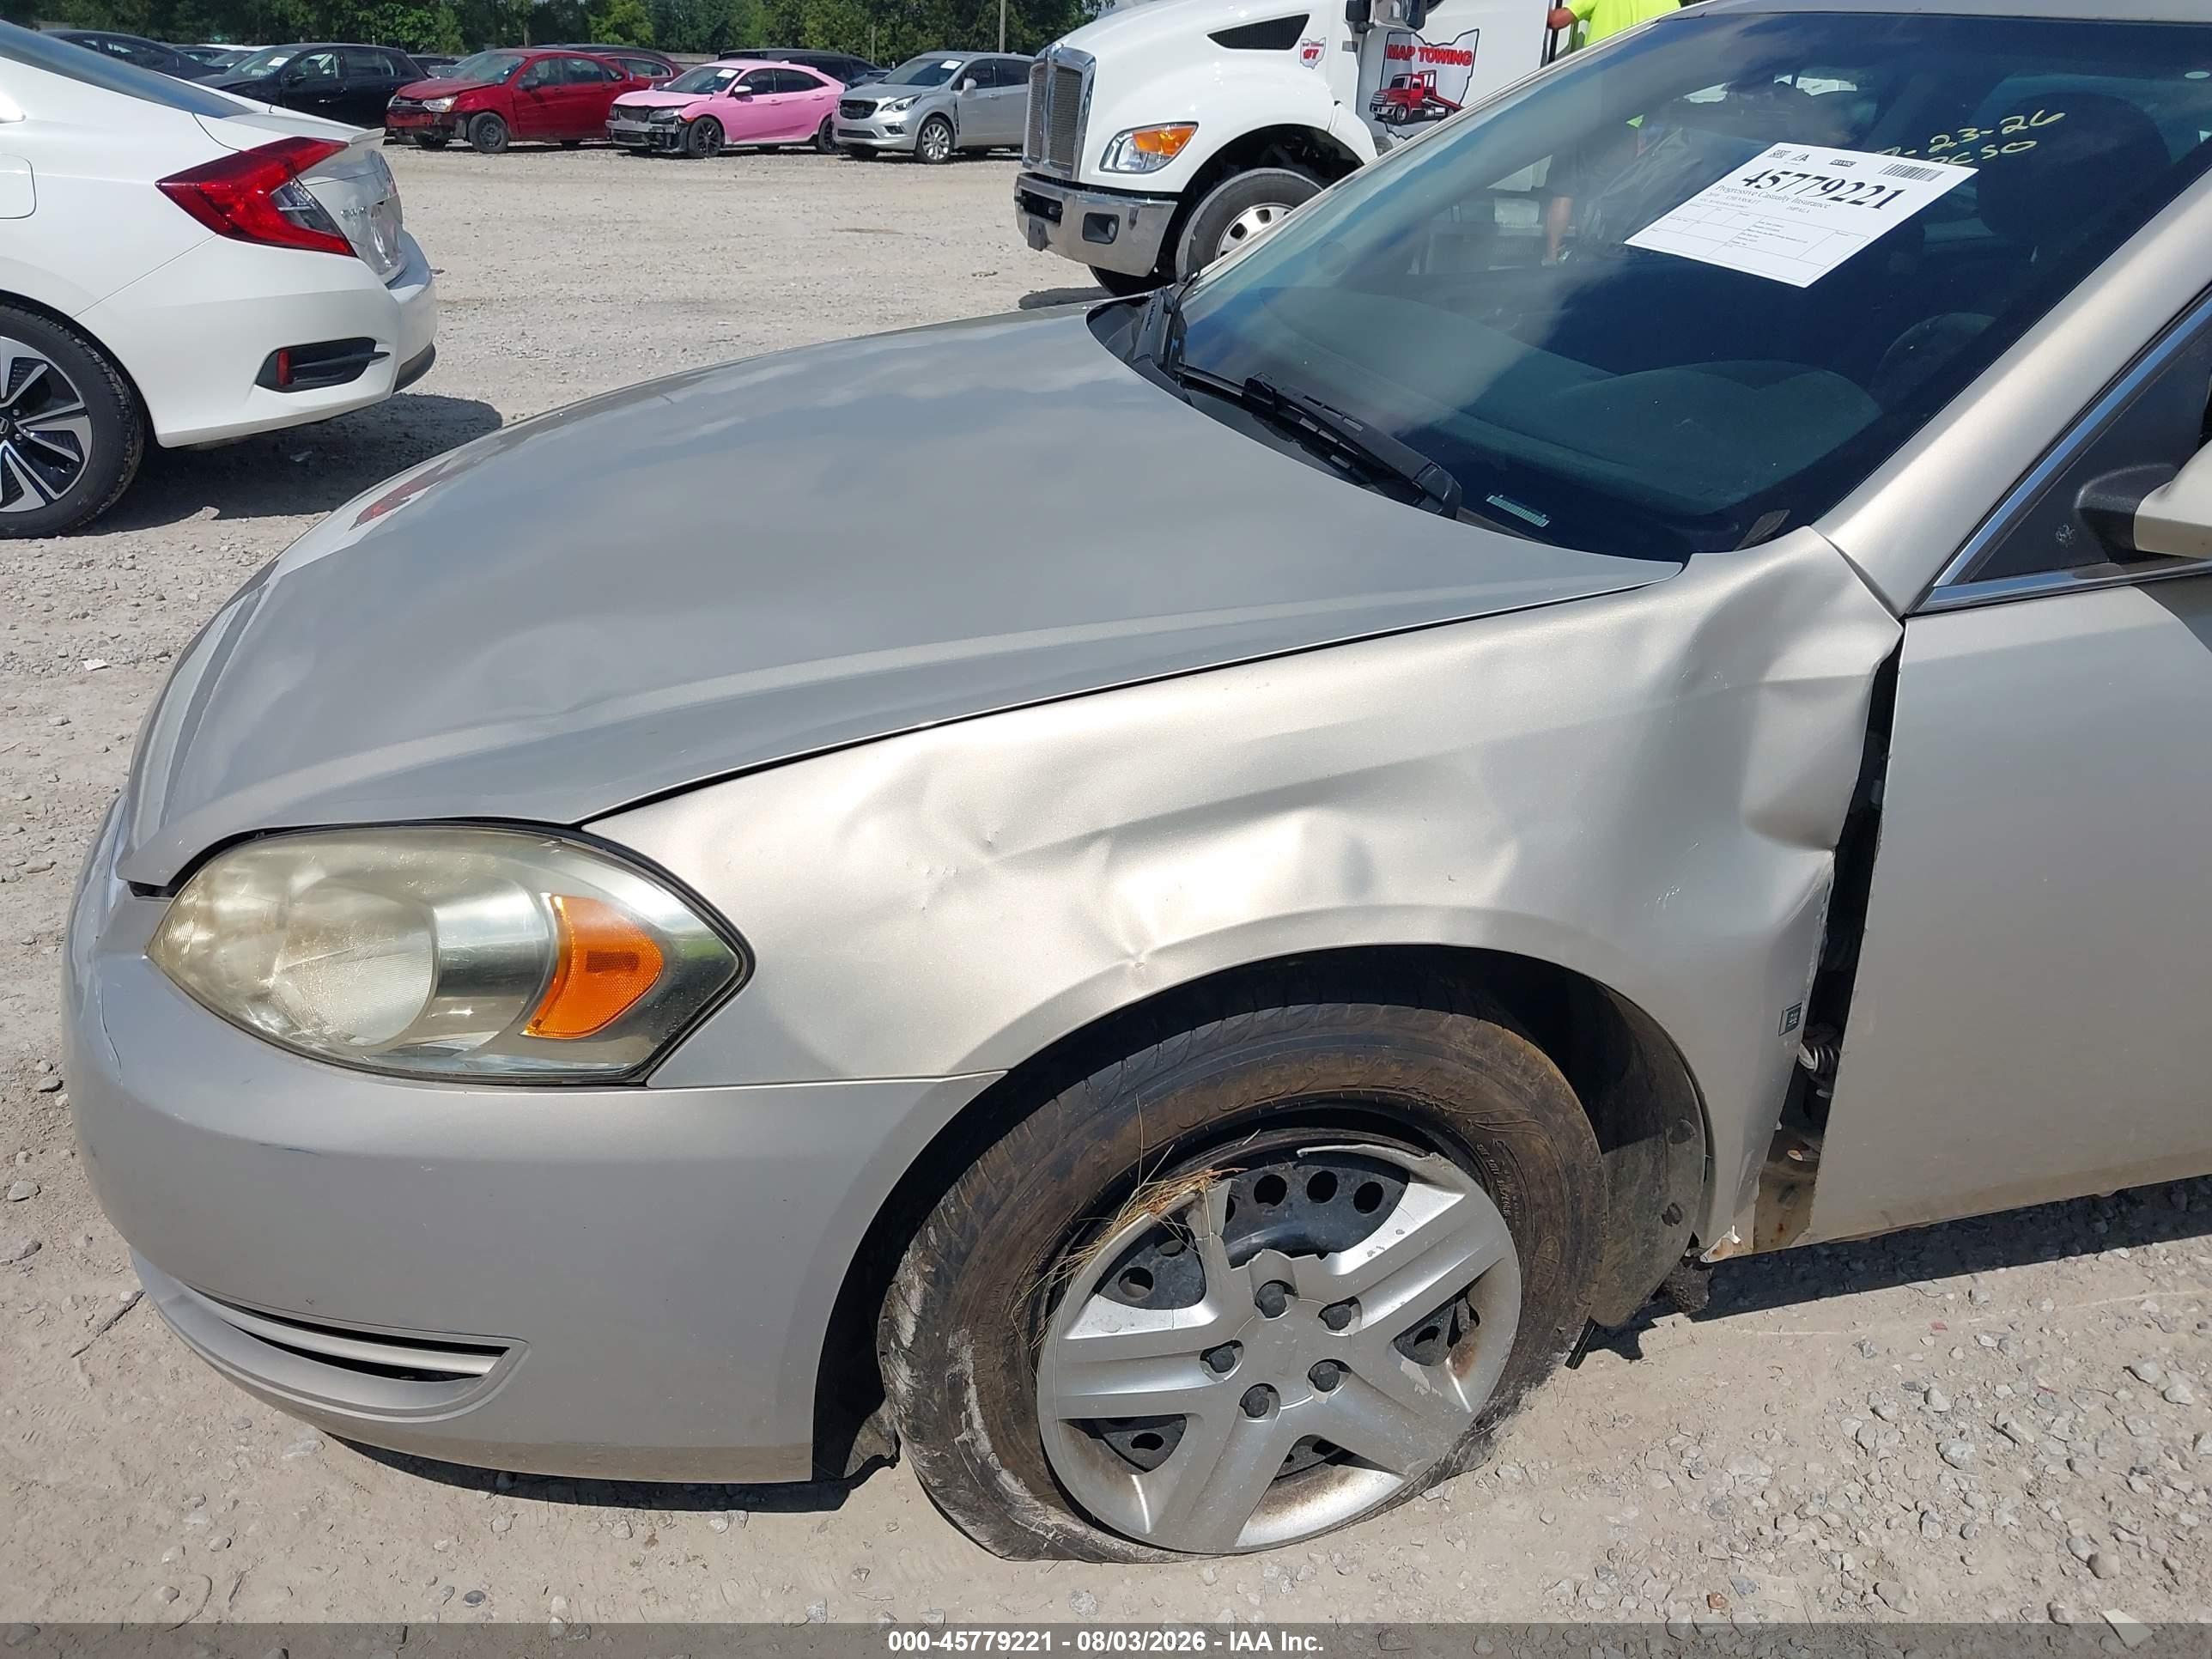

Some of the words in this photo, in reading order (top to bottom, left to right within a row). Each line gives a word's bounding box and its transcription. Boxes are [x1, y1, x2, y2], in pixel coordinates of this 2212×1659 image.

[1386, 44, 1415, 61] MAP
[1418, 46, 1474, 66] TOWING
[1715, 185, 1759, 199] Progressive
[1758, 191, 1790, 204] Casualty
[1790, 196, 1832, 210] Insurance
[1741, 168, 1906, 210] 45779221
